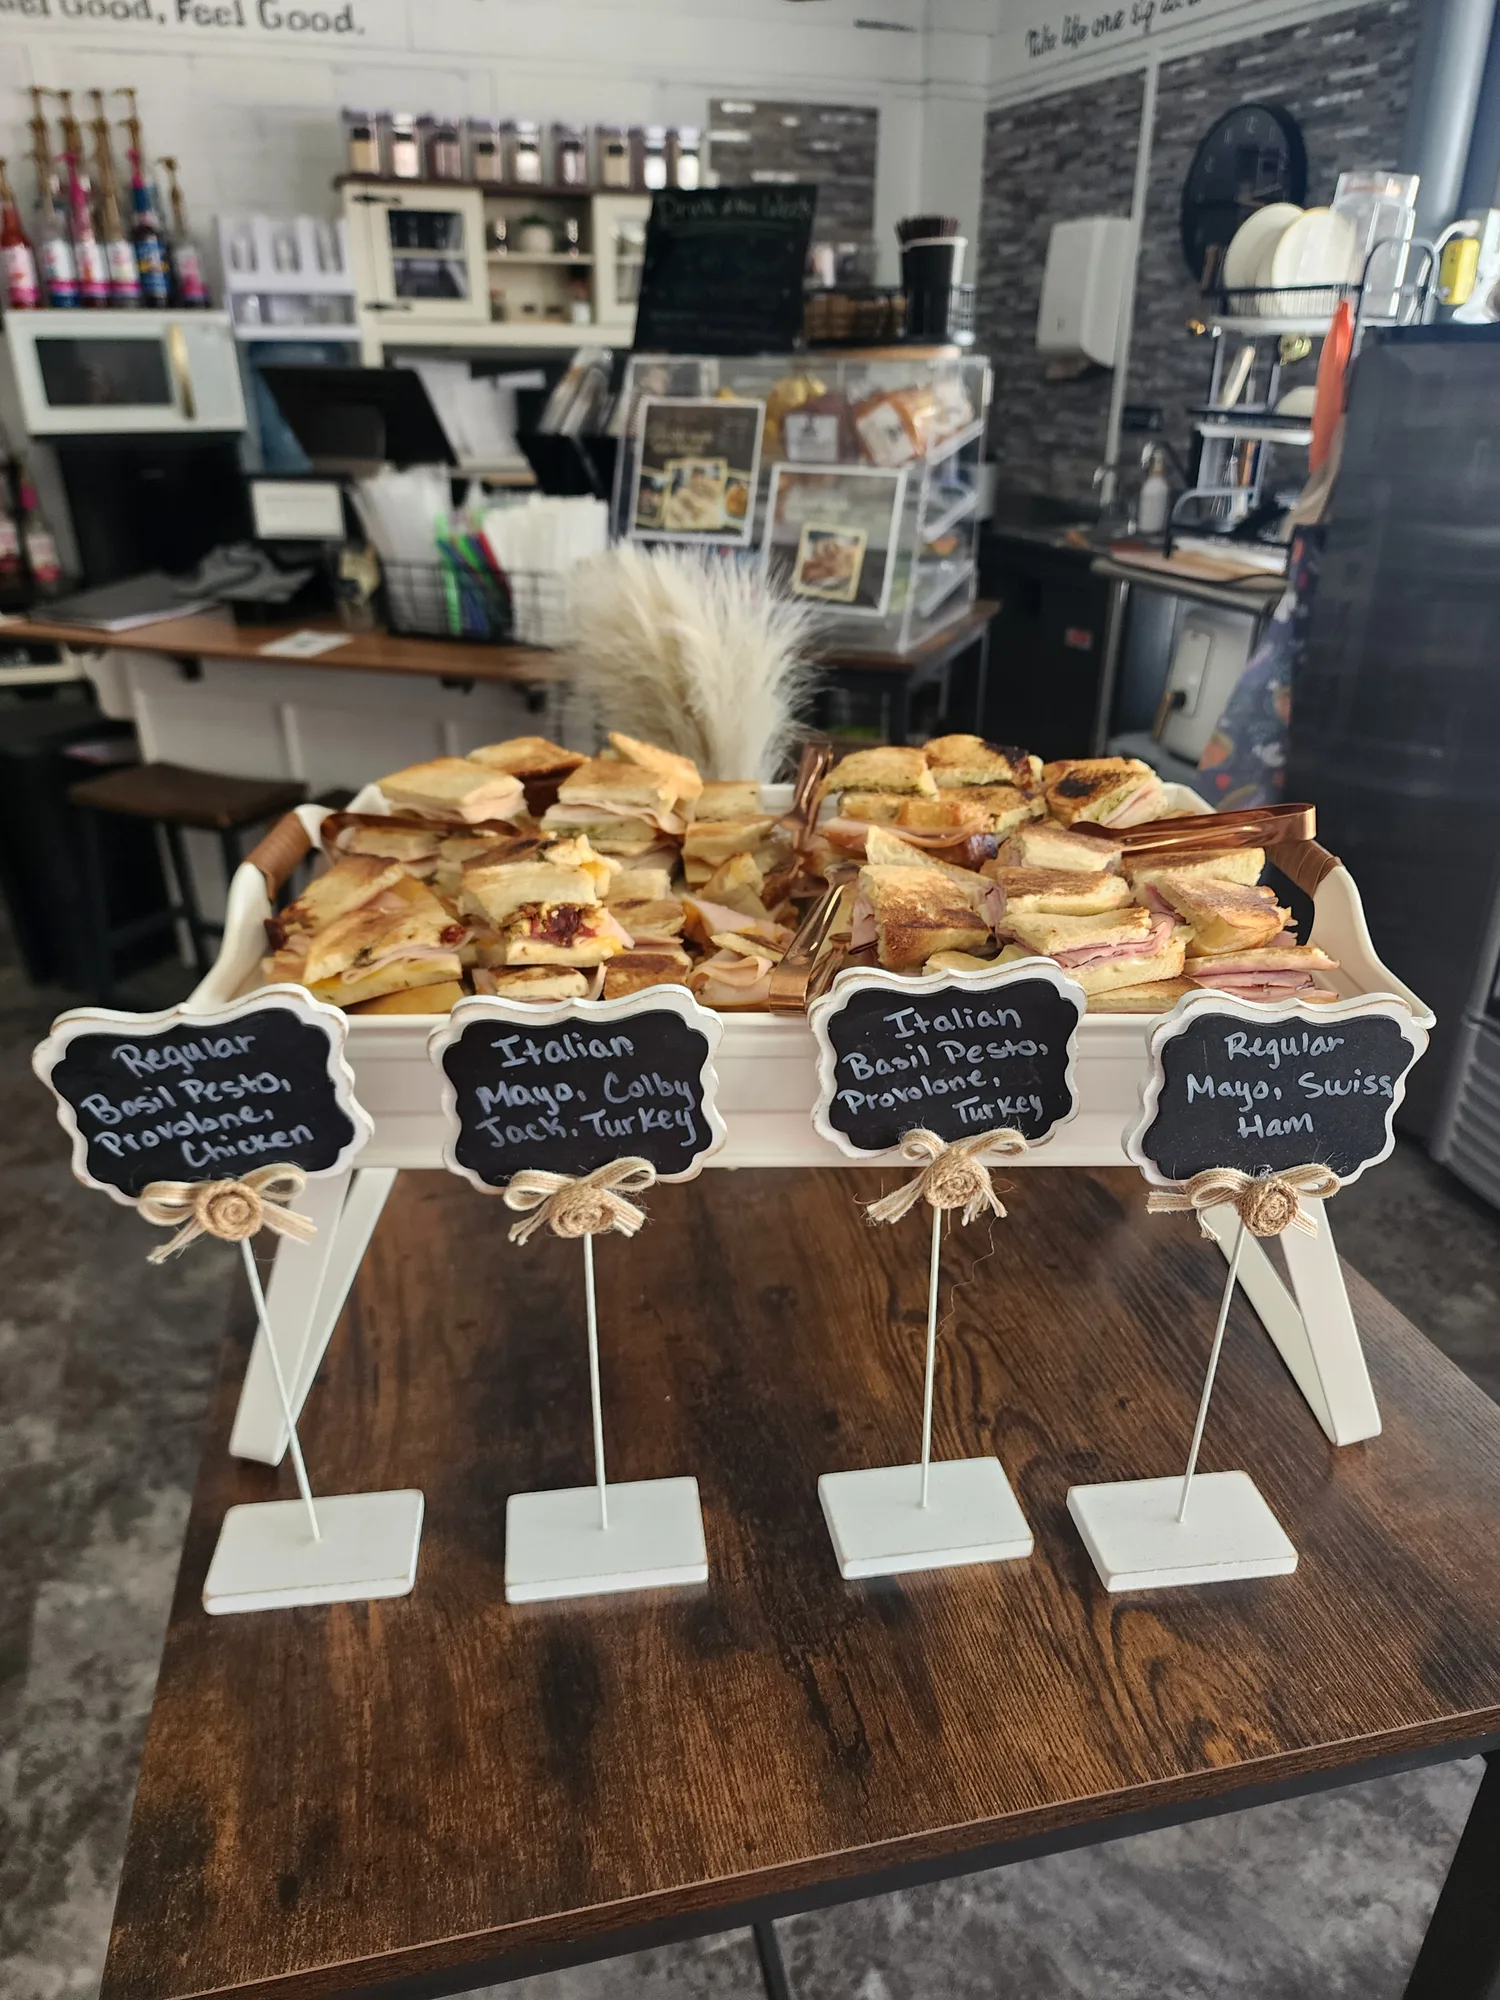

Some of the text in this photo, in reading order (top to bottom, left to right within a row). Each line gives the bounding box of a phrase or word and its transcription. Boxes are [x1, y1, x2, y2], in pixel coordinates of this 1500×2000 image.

[59, 0, 166, 25] Good,
[175, 0, 246, 27] Feel
[256, 0, 366, 35] Good.
[1061, 13, 1089, 49] life
[1091, 9, 1124, 38] one
[885, 1007, 1020, 1037] Italian
[112, 1034, 256, 1077] Regular
[492, 1032, 634, 1067] Italian
[843, 1039, 1047, 1080] Basil Pesto,
[1225, 1032, 1344, 1069] Regular
[82, 1073, 291, 1124] Basil Pesto,
[604, 1072, 694, 1108] Colby
[838, 1070, 998, 1113] Provolone,
[953, 1094, 1043, 1122] Turkey
[1187, 1074, 1281, 1111] Mayo,
[95, 1107, 274, 1156] Provolone,
[581, 1108, 696, 1146] Turkey
[1238, 1113, 1312, 1138] Ham
[183, 1124, 313, 1166] Chicken
